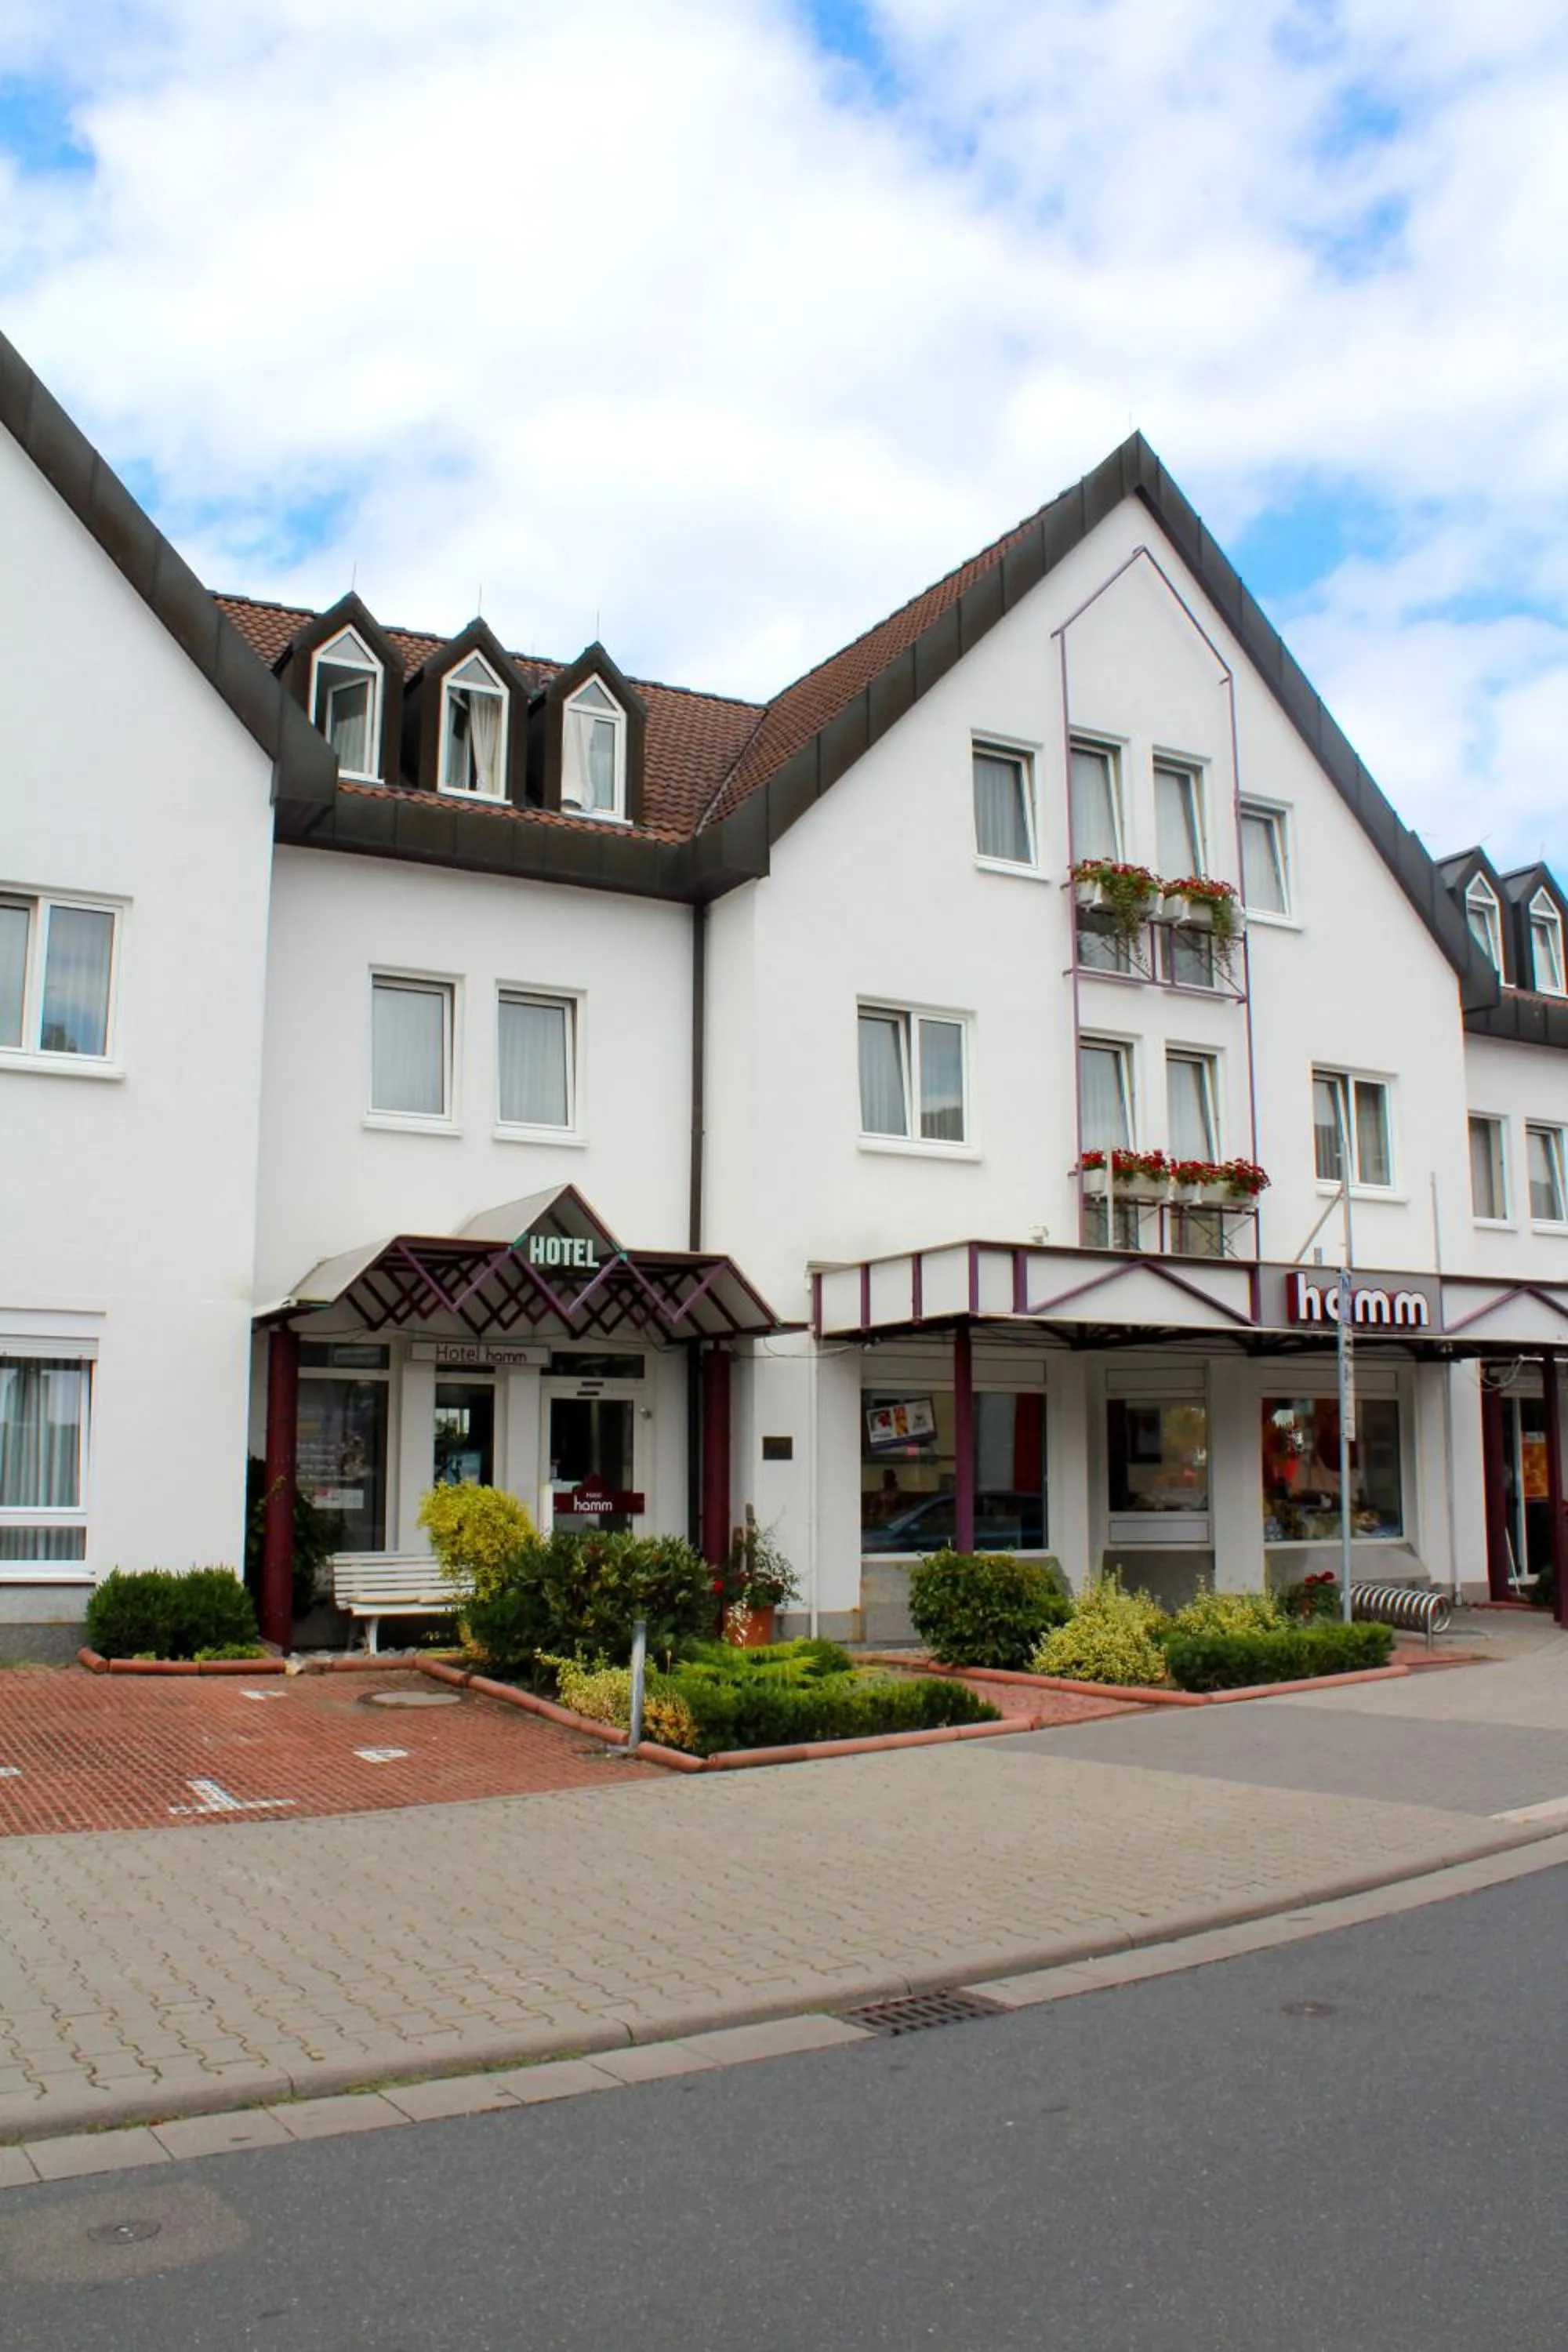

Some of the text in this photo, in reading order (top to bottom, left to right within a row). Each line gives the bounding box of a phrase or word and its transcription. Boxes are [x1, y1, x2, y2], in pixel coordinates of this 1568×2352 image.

[530, 1236, 600, 1267] HOTEL
[436, 1342, 528, 1363] Hotel hamm
[574, 1495, 612, 1512] hamm
